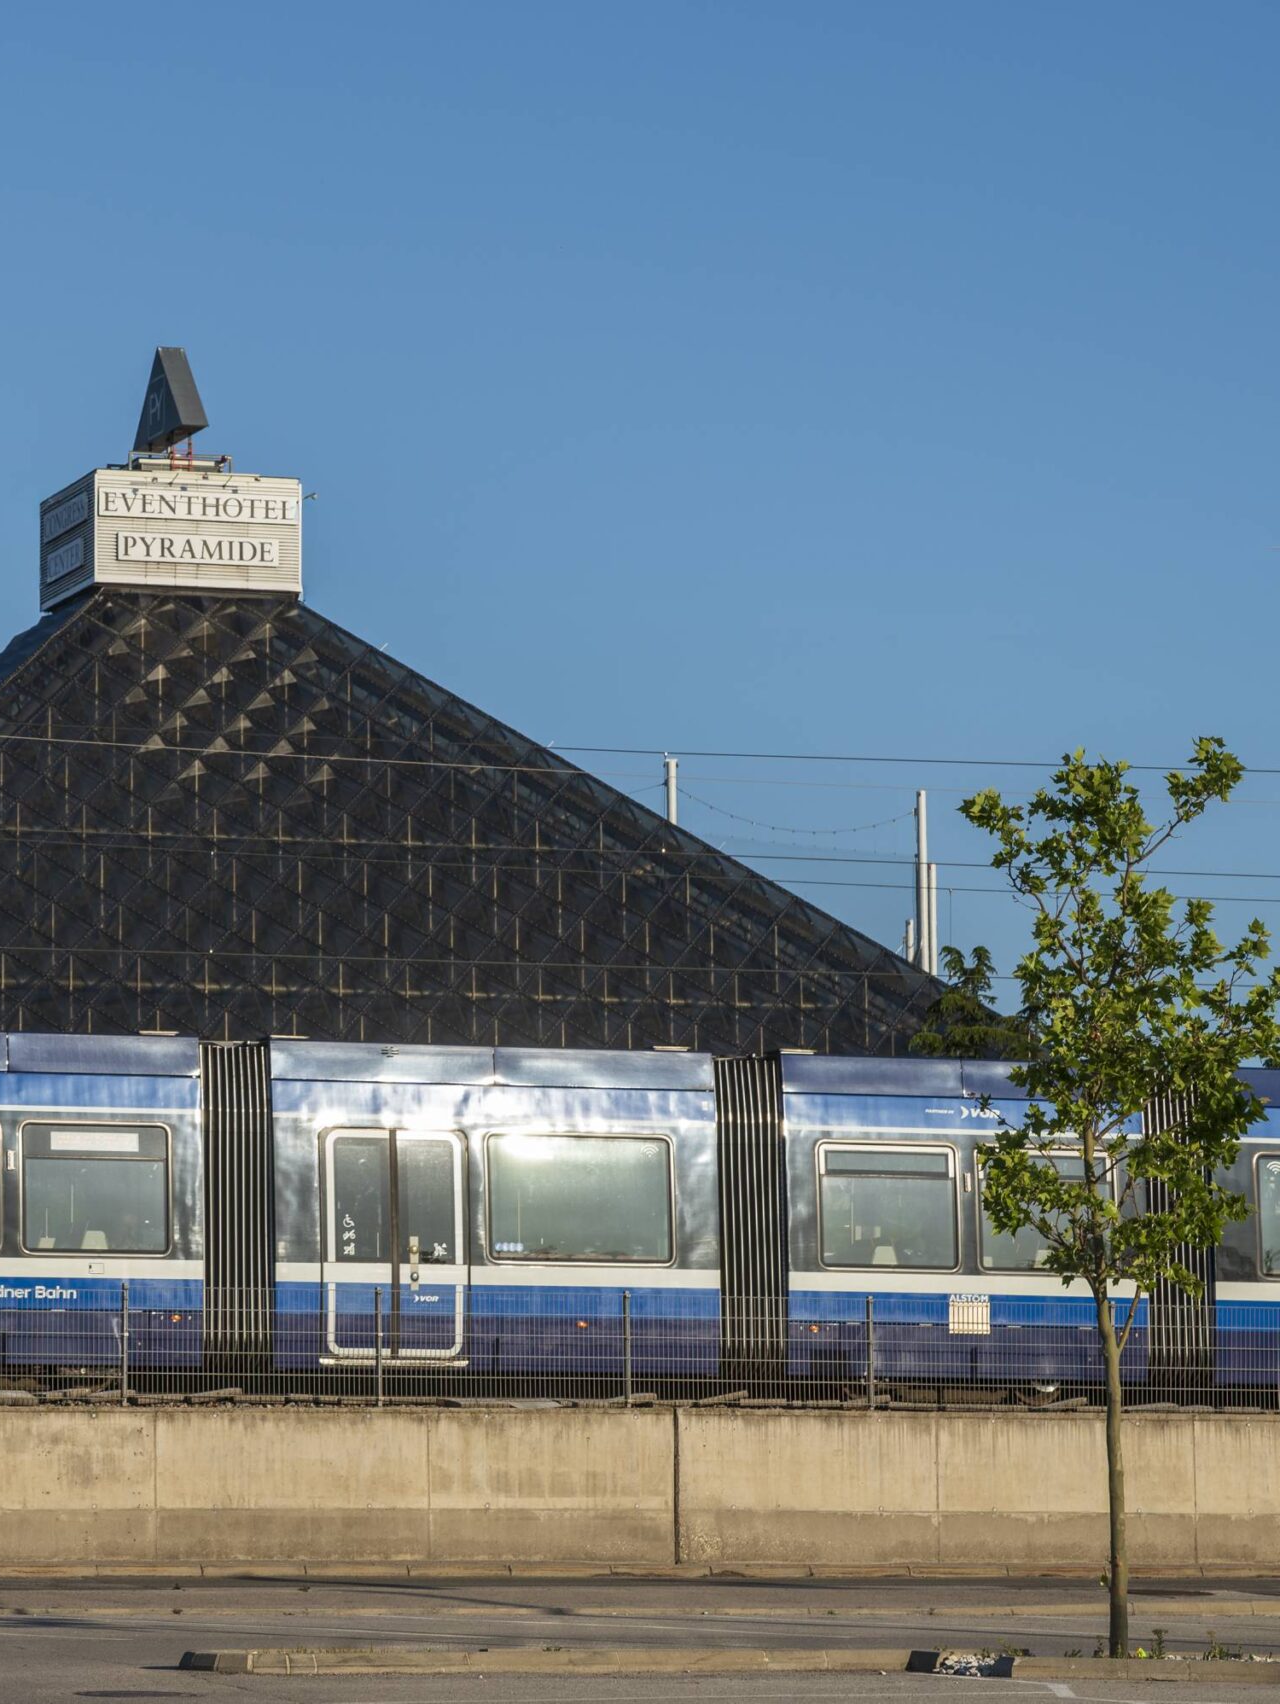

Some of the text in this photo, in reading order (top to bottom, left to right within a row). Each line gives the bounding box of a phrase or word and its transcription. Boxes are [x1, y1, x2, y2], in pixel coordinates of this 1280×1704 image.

[103, 491, 294, 520] EVENTHOTEL
[49, 543, 80, 577] CENTER
[123, 535, 275, 563] PYRAMIDE
[34, 1286, 77, 1299] Bahn
[949, 1294, 989, 1302] ALSTOM
